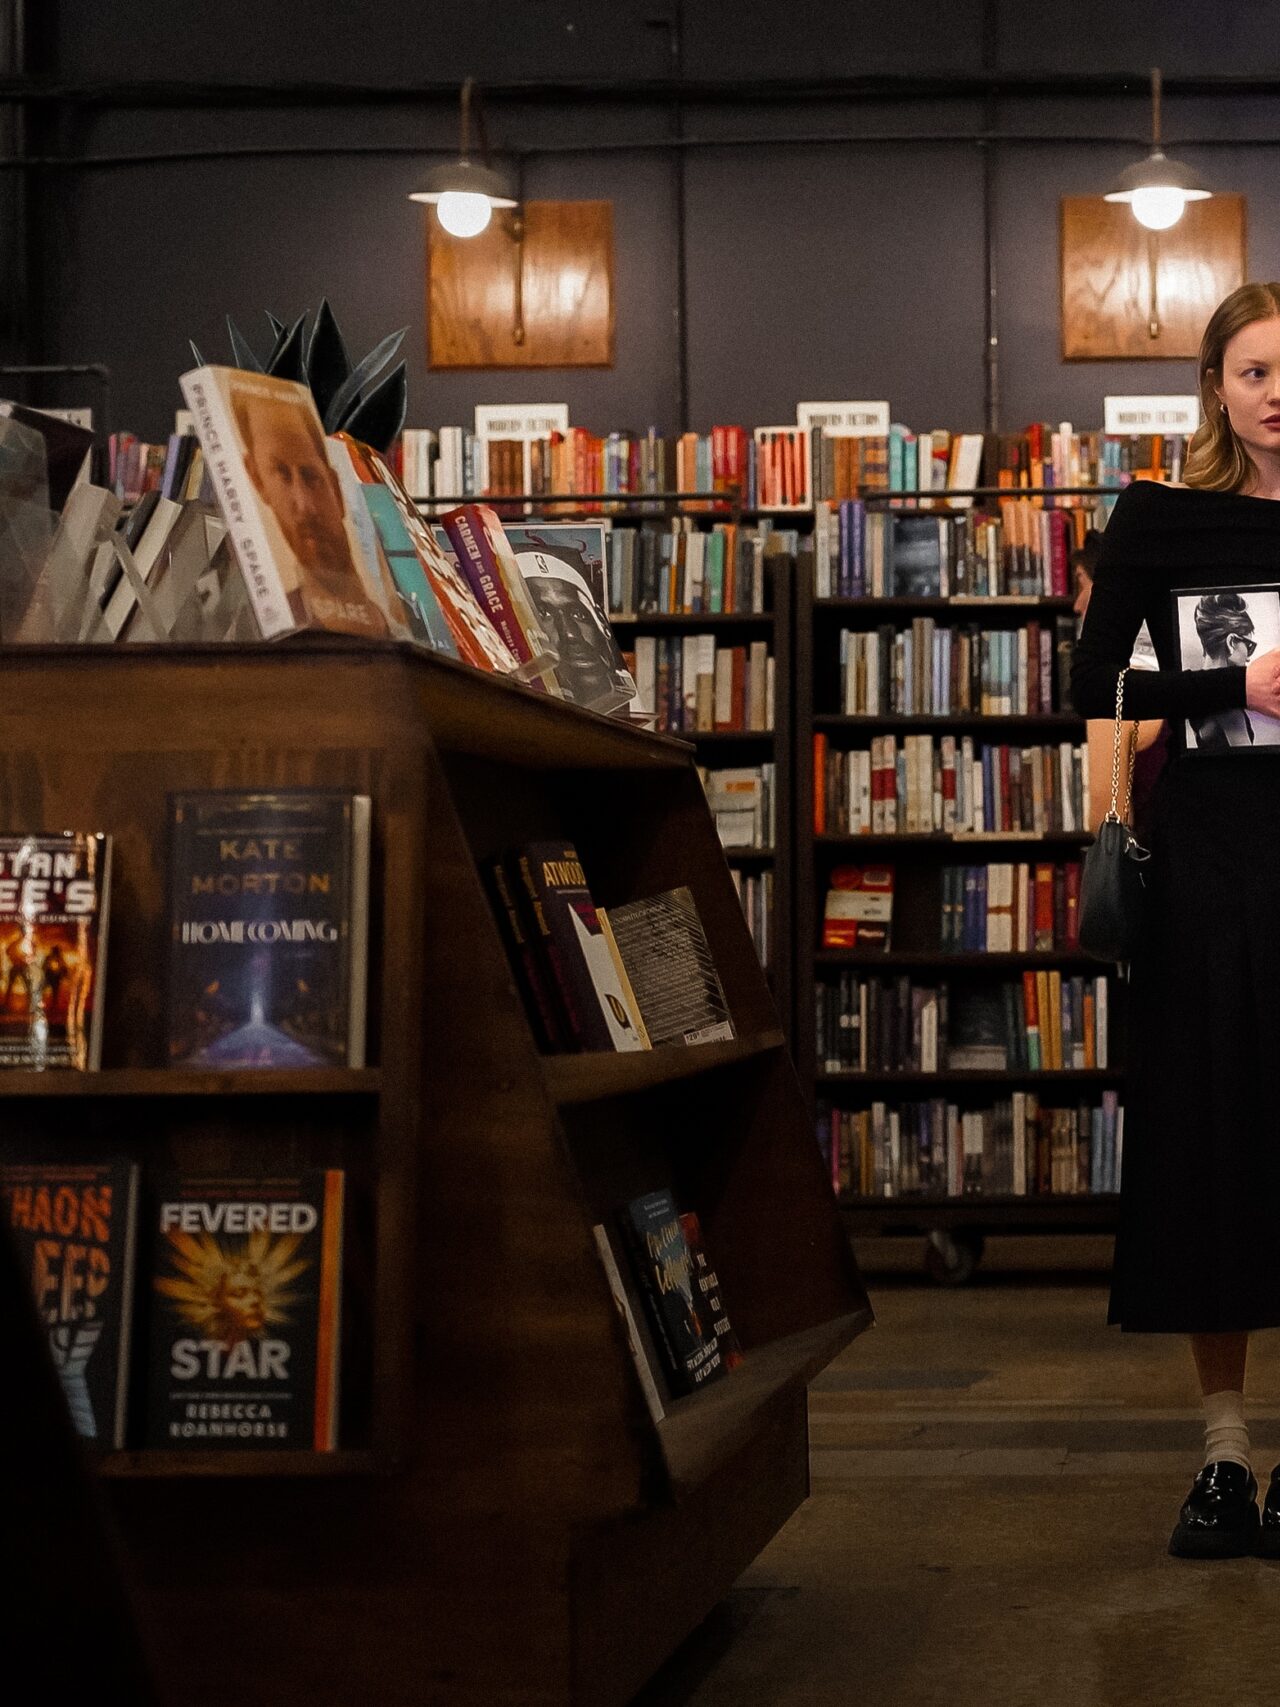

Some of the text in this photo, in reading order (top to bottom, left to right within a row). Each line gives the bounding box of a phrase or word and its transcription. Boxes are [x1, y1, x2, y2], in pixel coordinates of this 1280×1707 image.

[192, 384, 270, 602] PRINCE HARRY SPARE
[455, 515, 482, 563] CARMEN
[479, 575, 503, 614] GRACE
[219, 839, 302, 862] KATE
[0, 852, 77, 879] TAN
[191, 873, 332, 896] MORTON
[182, 919, 338, 944] HOMECOMING
[160, 1203, 318, 1234] FEVERED
[170, 1339, 292, 1381] STAR
[186, 1403, 272, 1419] REBECCA
[169, 1422, 289, 1438] ROANHORSE
